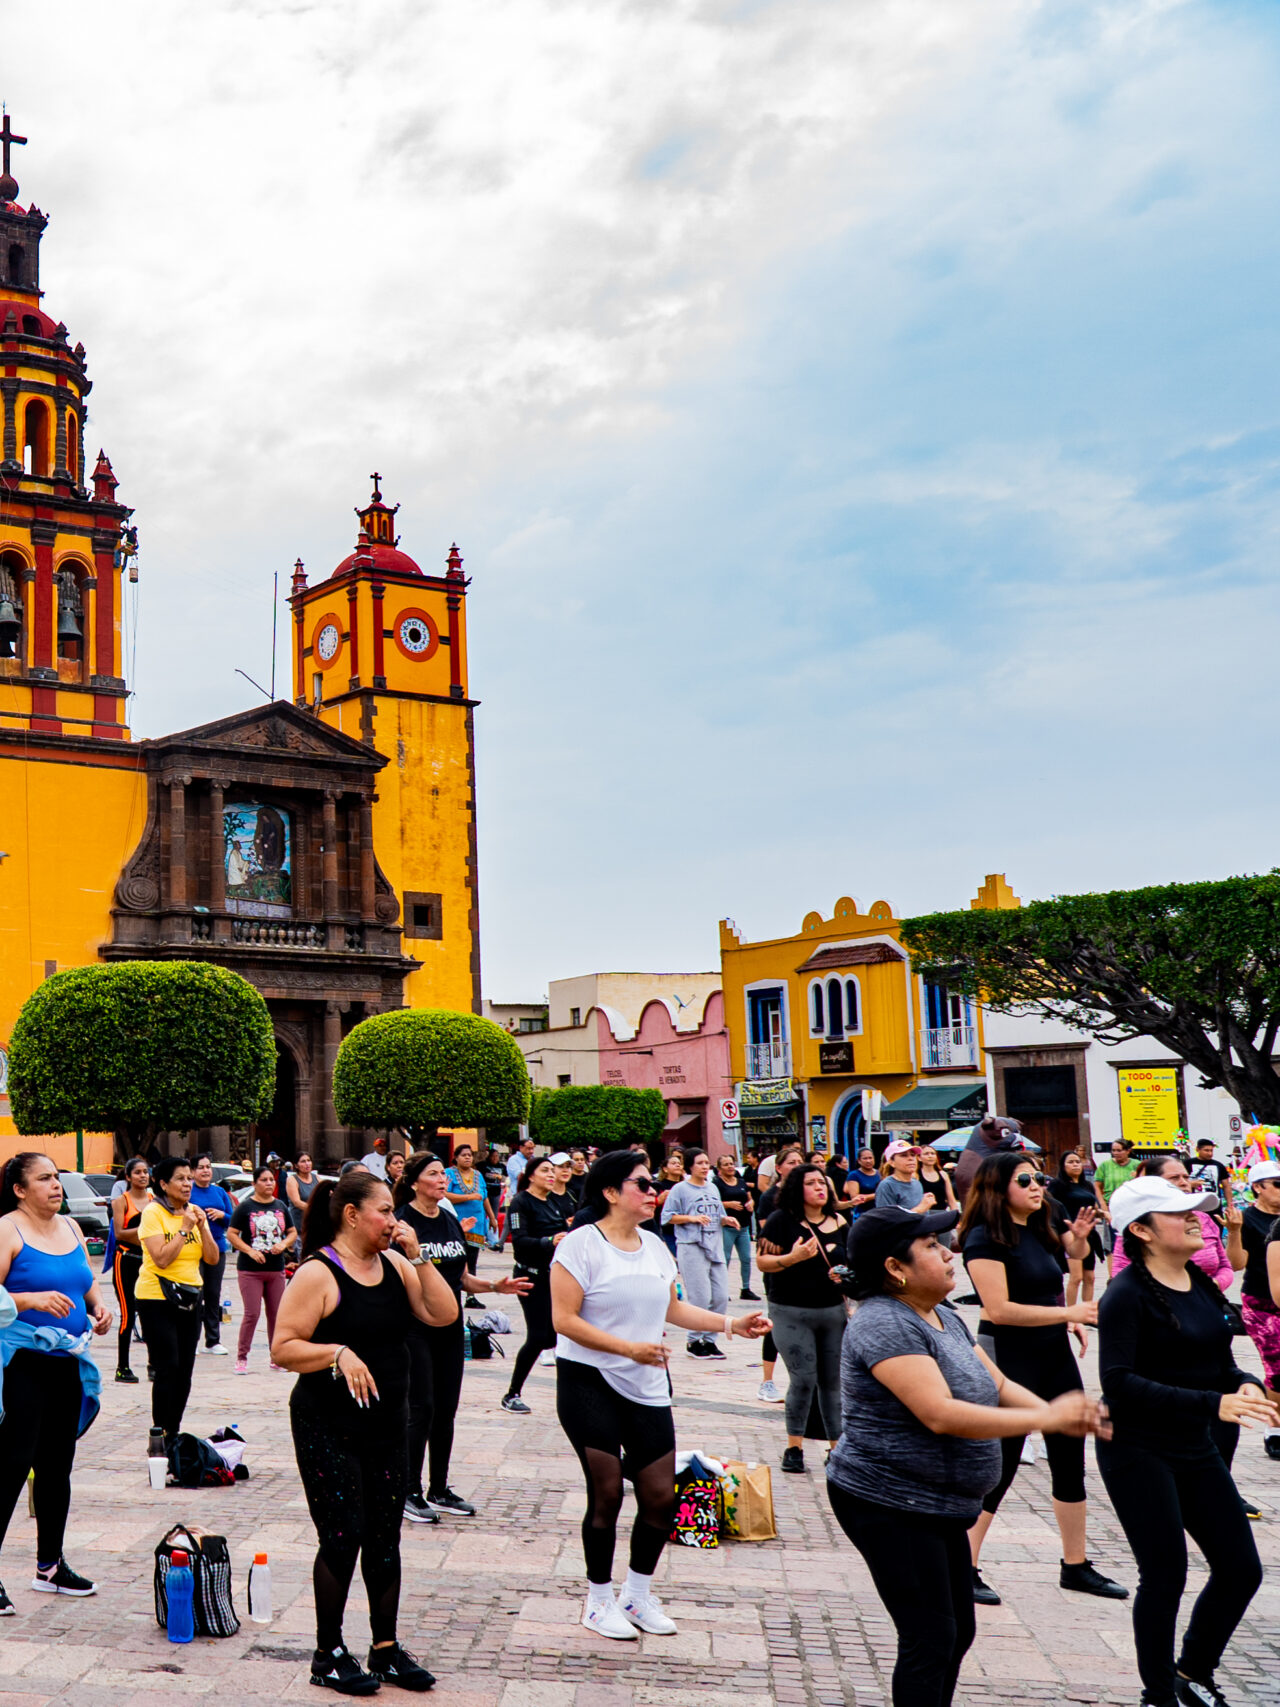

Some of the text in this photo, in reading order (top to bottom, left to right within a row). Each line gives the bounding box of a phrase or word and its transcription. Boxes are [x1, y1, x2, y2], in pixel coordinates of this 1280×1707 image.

[663, 1066, 681, 1074] TORTAS
[665, 1075, 686, 1084] VENADITO
[1128, 1072, 1153, 1080] TODO
[741, 1093, 759, 1104] ESTE
[696, 1203, 719, 1213] CITY
